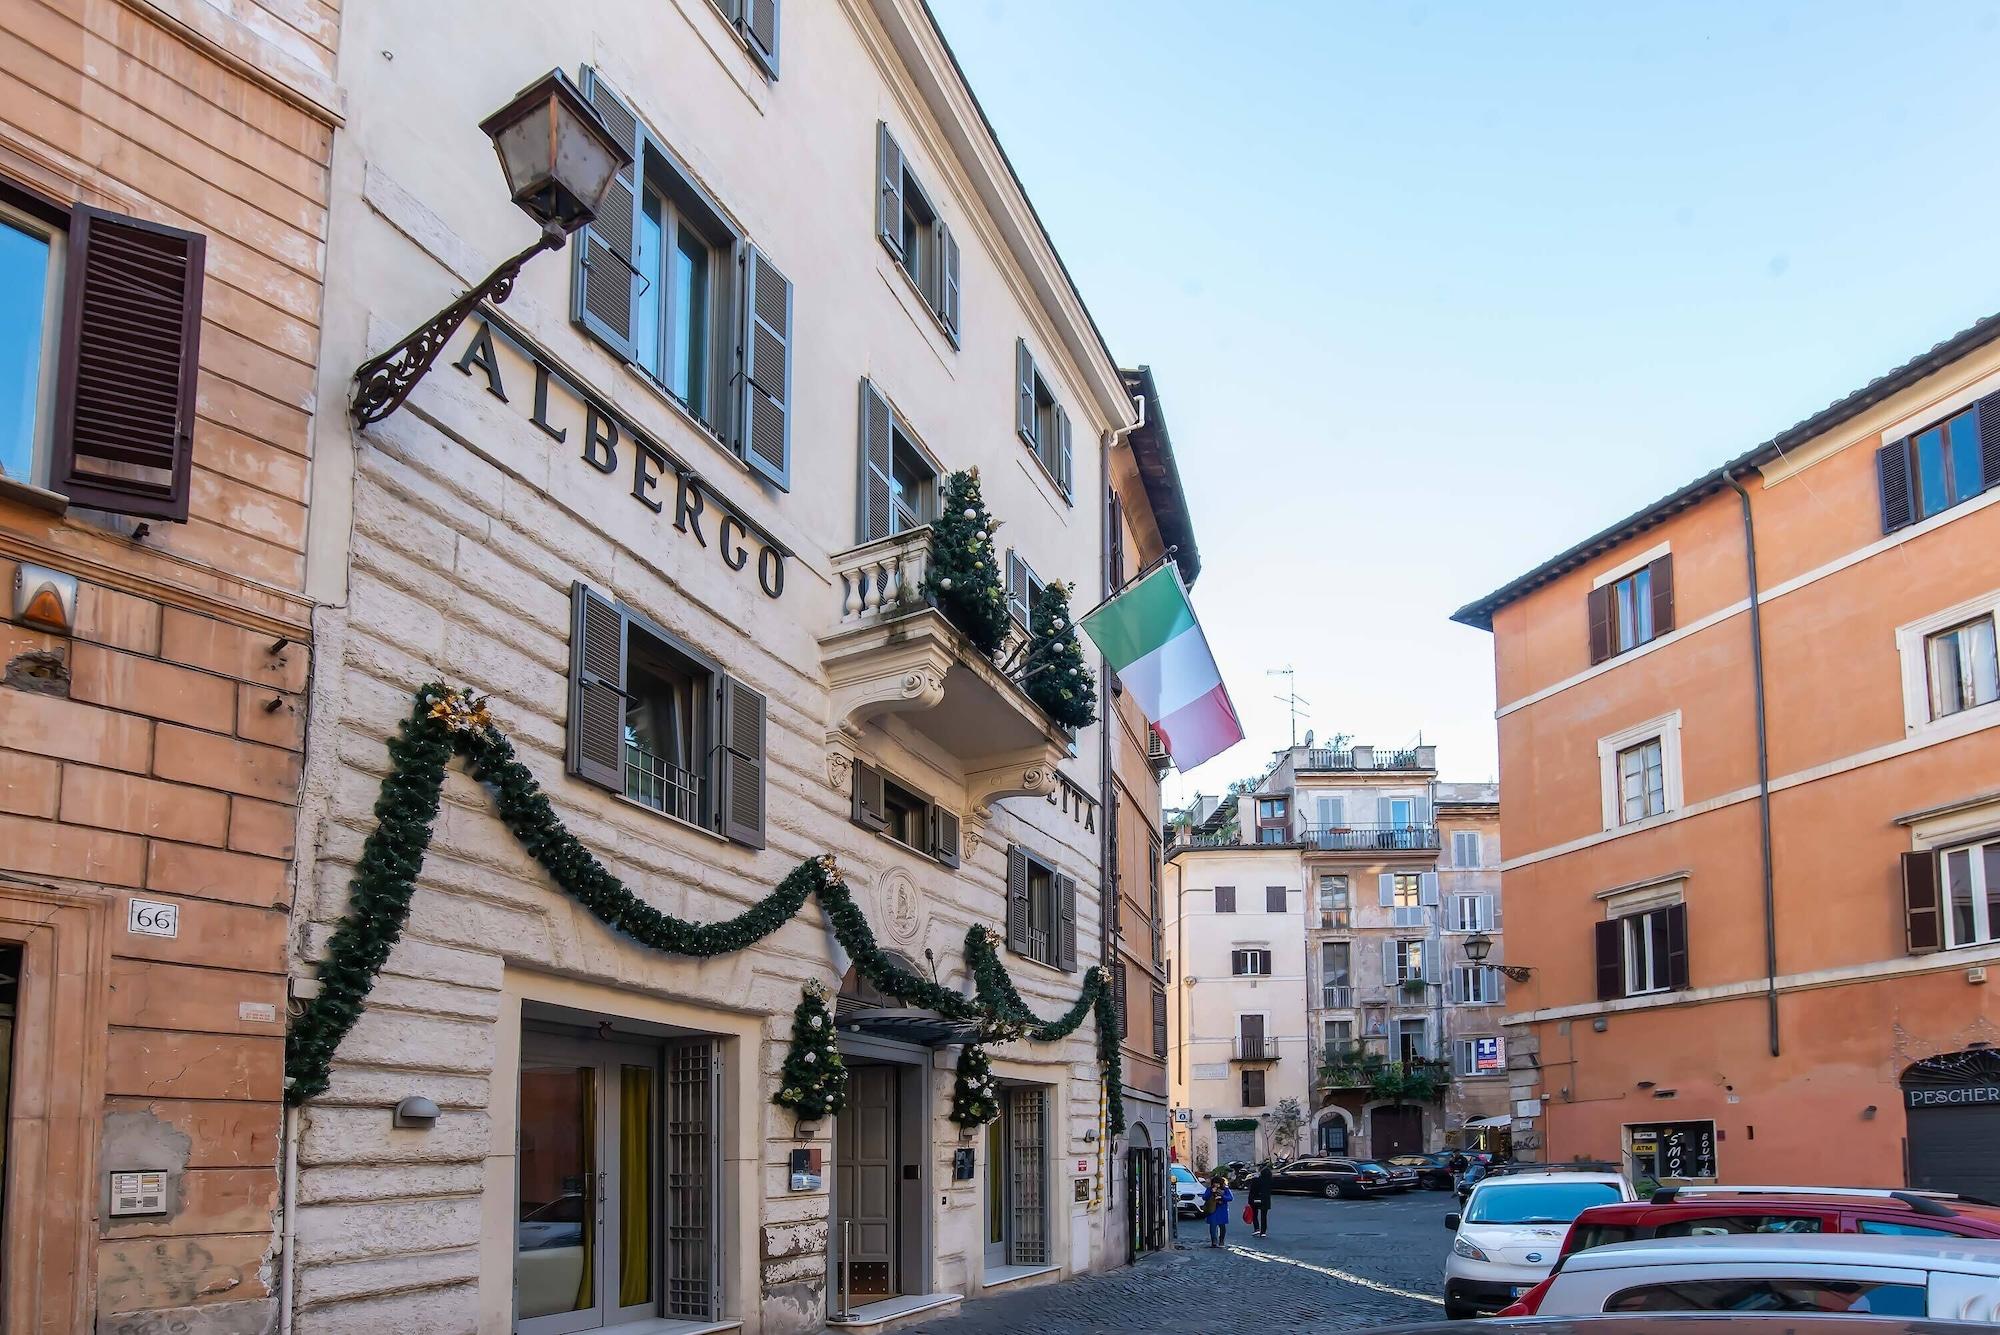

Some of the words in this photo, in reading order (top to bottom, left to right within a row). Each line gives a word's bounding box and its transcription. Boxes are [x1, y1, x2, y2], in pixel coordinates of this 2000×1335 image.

[453, 321, 785, 599] ALBERGO
[137, 907, 171, 929] 66
[1910, 1087, 2000, 1107] PESCHER
